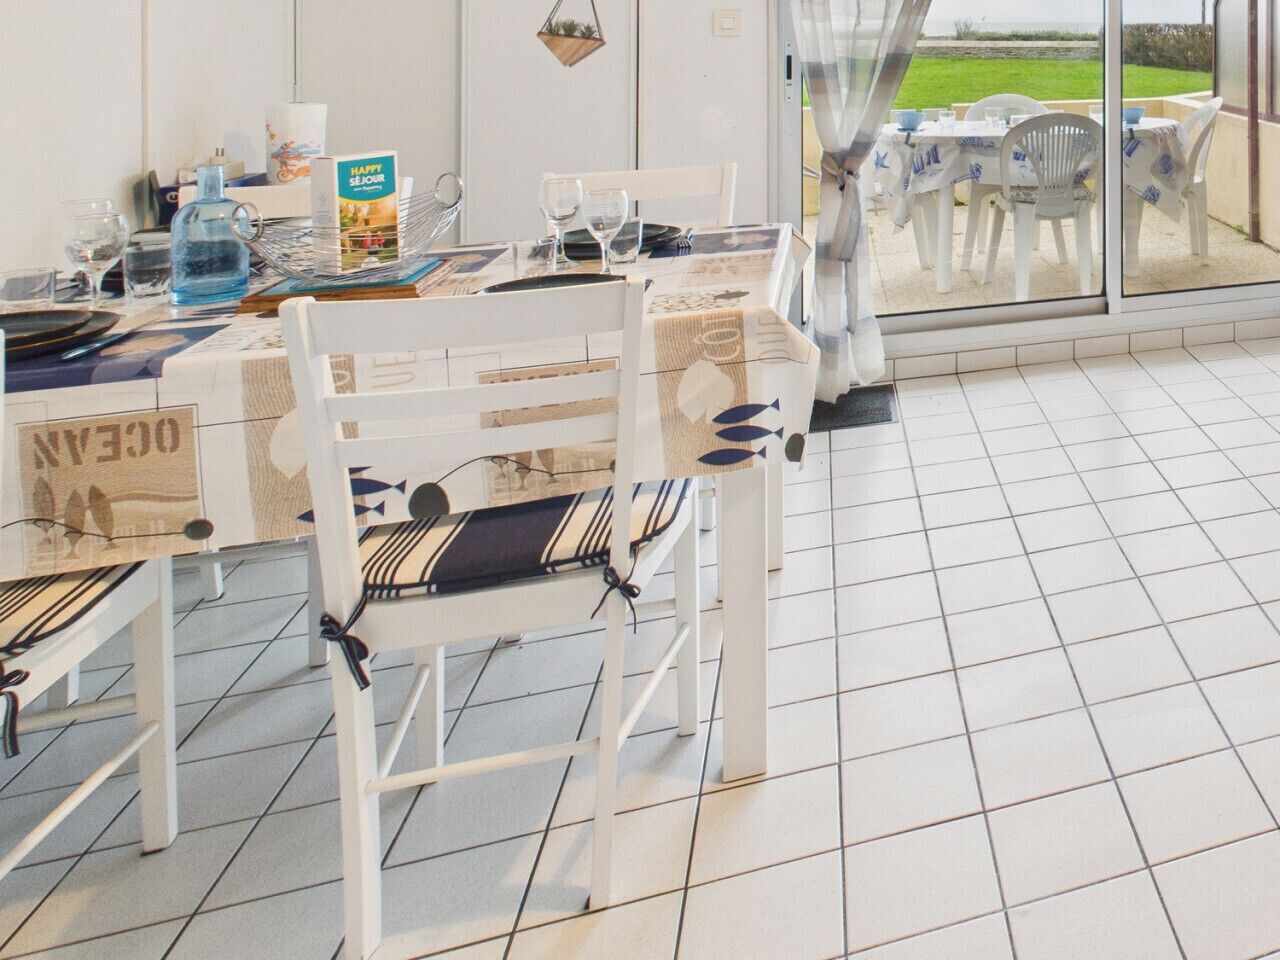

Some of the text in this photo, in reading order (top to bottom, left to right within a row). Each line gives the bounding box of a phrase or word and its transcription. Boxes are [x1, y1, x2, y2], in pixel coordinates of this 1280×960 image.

[351, 164, 382, 175] HAPPY
[349, 173, 385, 186] SÉJOUR
[33, 417, 180, 470] OCEAN
